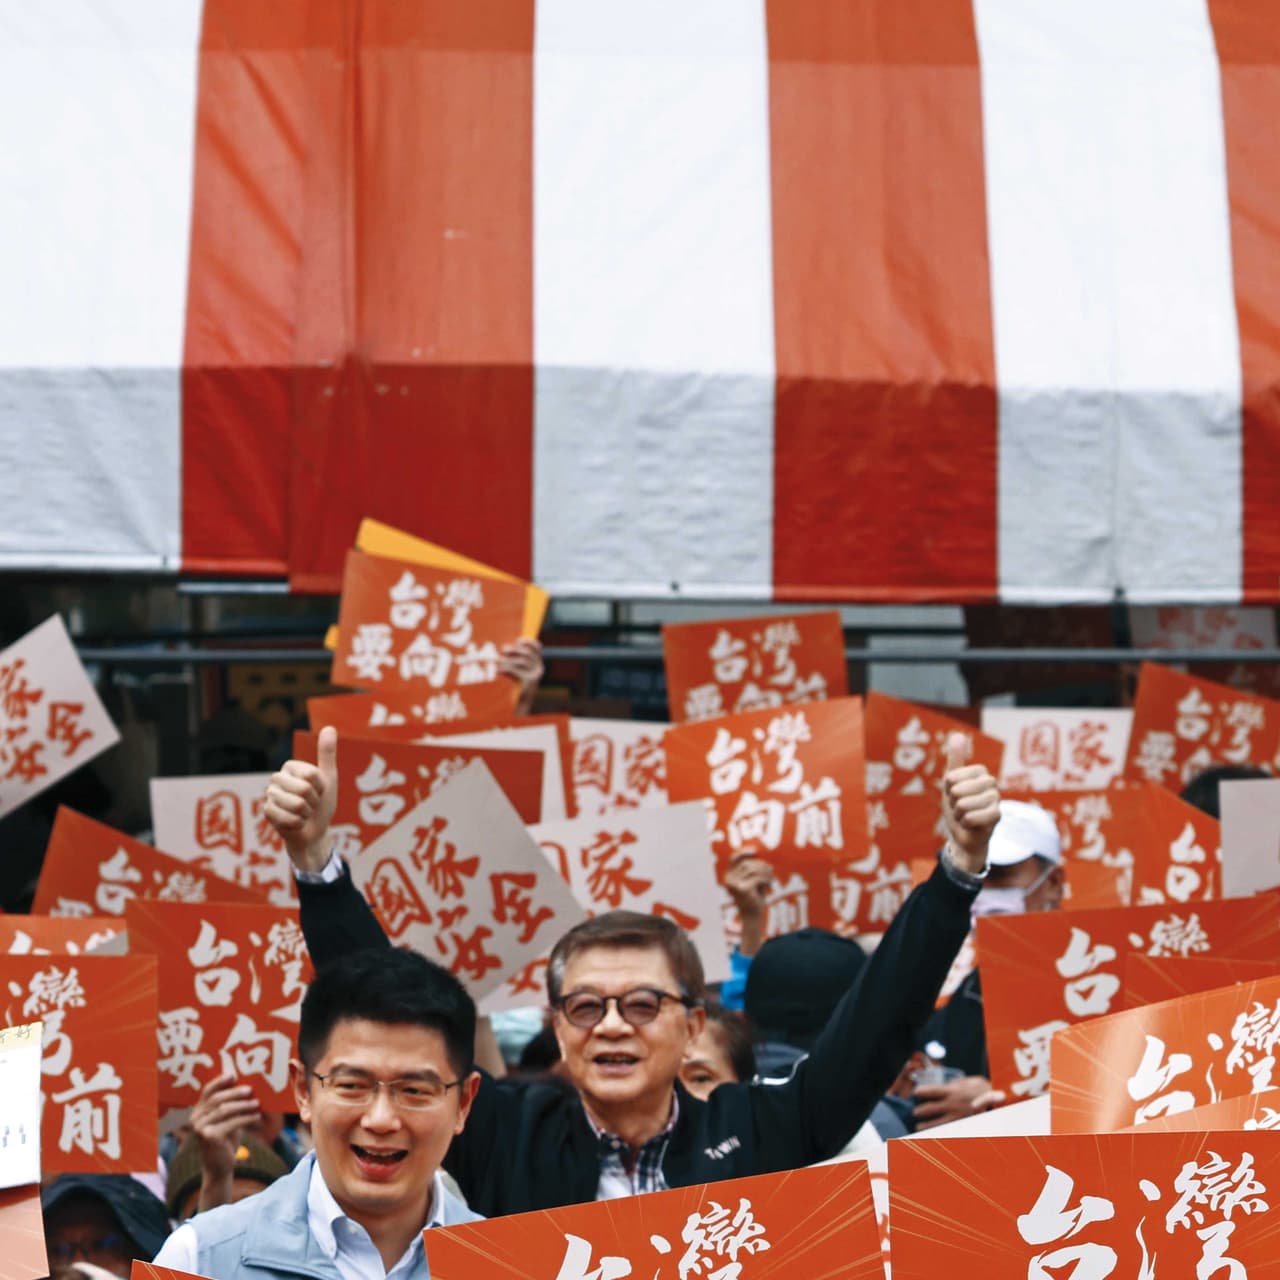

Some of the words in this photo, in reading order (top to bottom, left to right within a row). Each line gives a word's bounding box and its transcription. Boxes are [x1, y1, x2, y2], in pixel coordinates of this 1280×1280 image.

[390, 570, 484, 646] 台灣
[347, 624, 500, 687] 要向前
[710, 621, 800, 685] 台灣
[0, 700, 94, 784] 安全
[572, 734, 667, 795] 國家
[707, 711, 811, 795] 台灣
[1020, 720, 1113, 774] 國家
[1177, 688, 1265, 764] 台灣
[365, 817, 479, 937] 國家
[537, 830, 653, 908] 家
[400, 873, 554, 980] 安全
[157, 1007, 292, 1093] 要向
